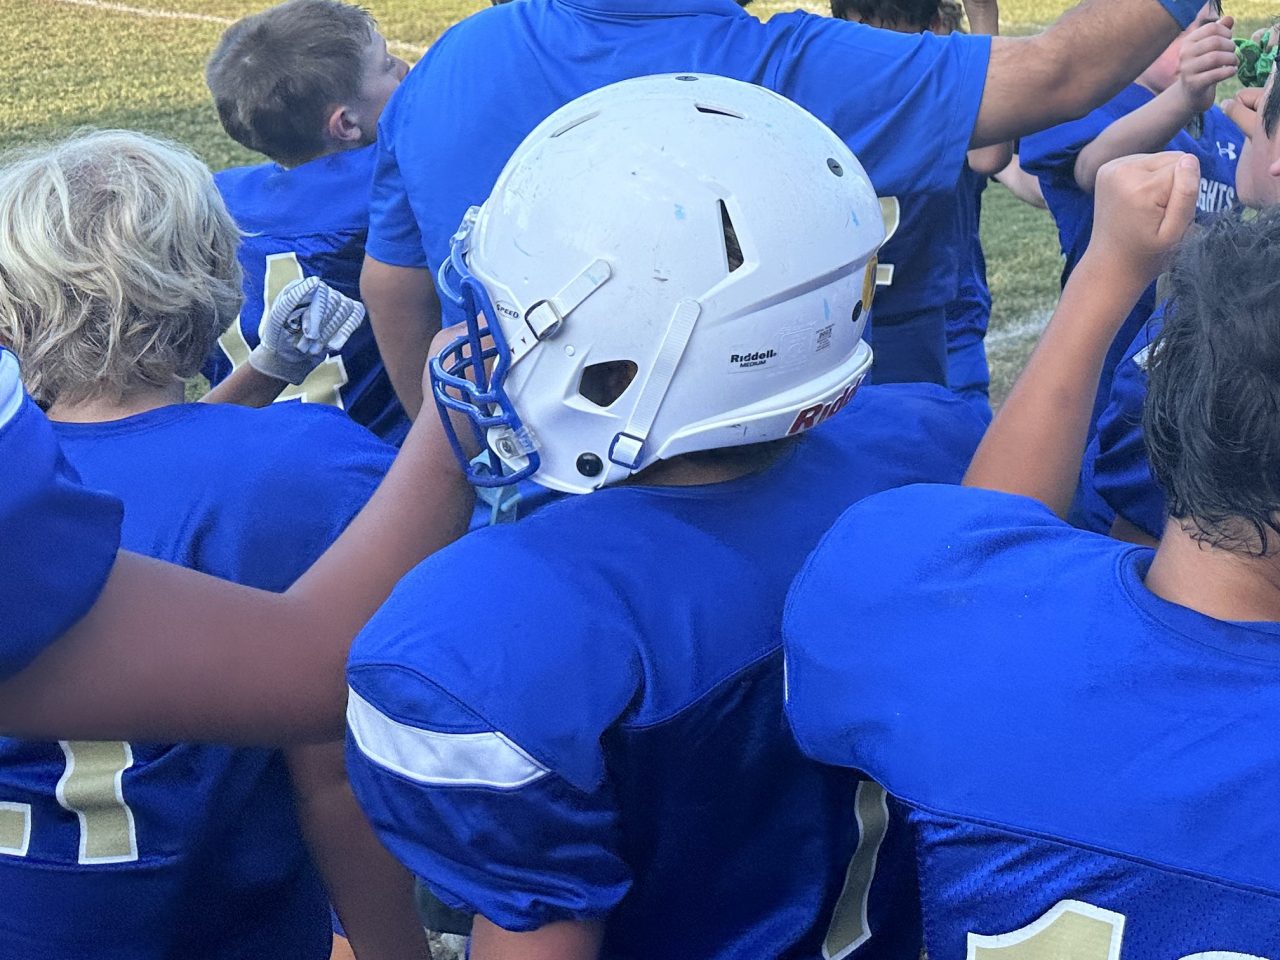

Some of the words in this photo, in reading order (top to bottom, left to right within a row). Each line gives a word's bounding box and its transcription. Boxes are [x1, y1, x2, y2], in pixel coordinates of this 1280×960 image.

[1196, 177, 1235, 214] GHTS
[496, 303, 519, 319] SPEED
[740, 360, 767, 368] MEDIUM
